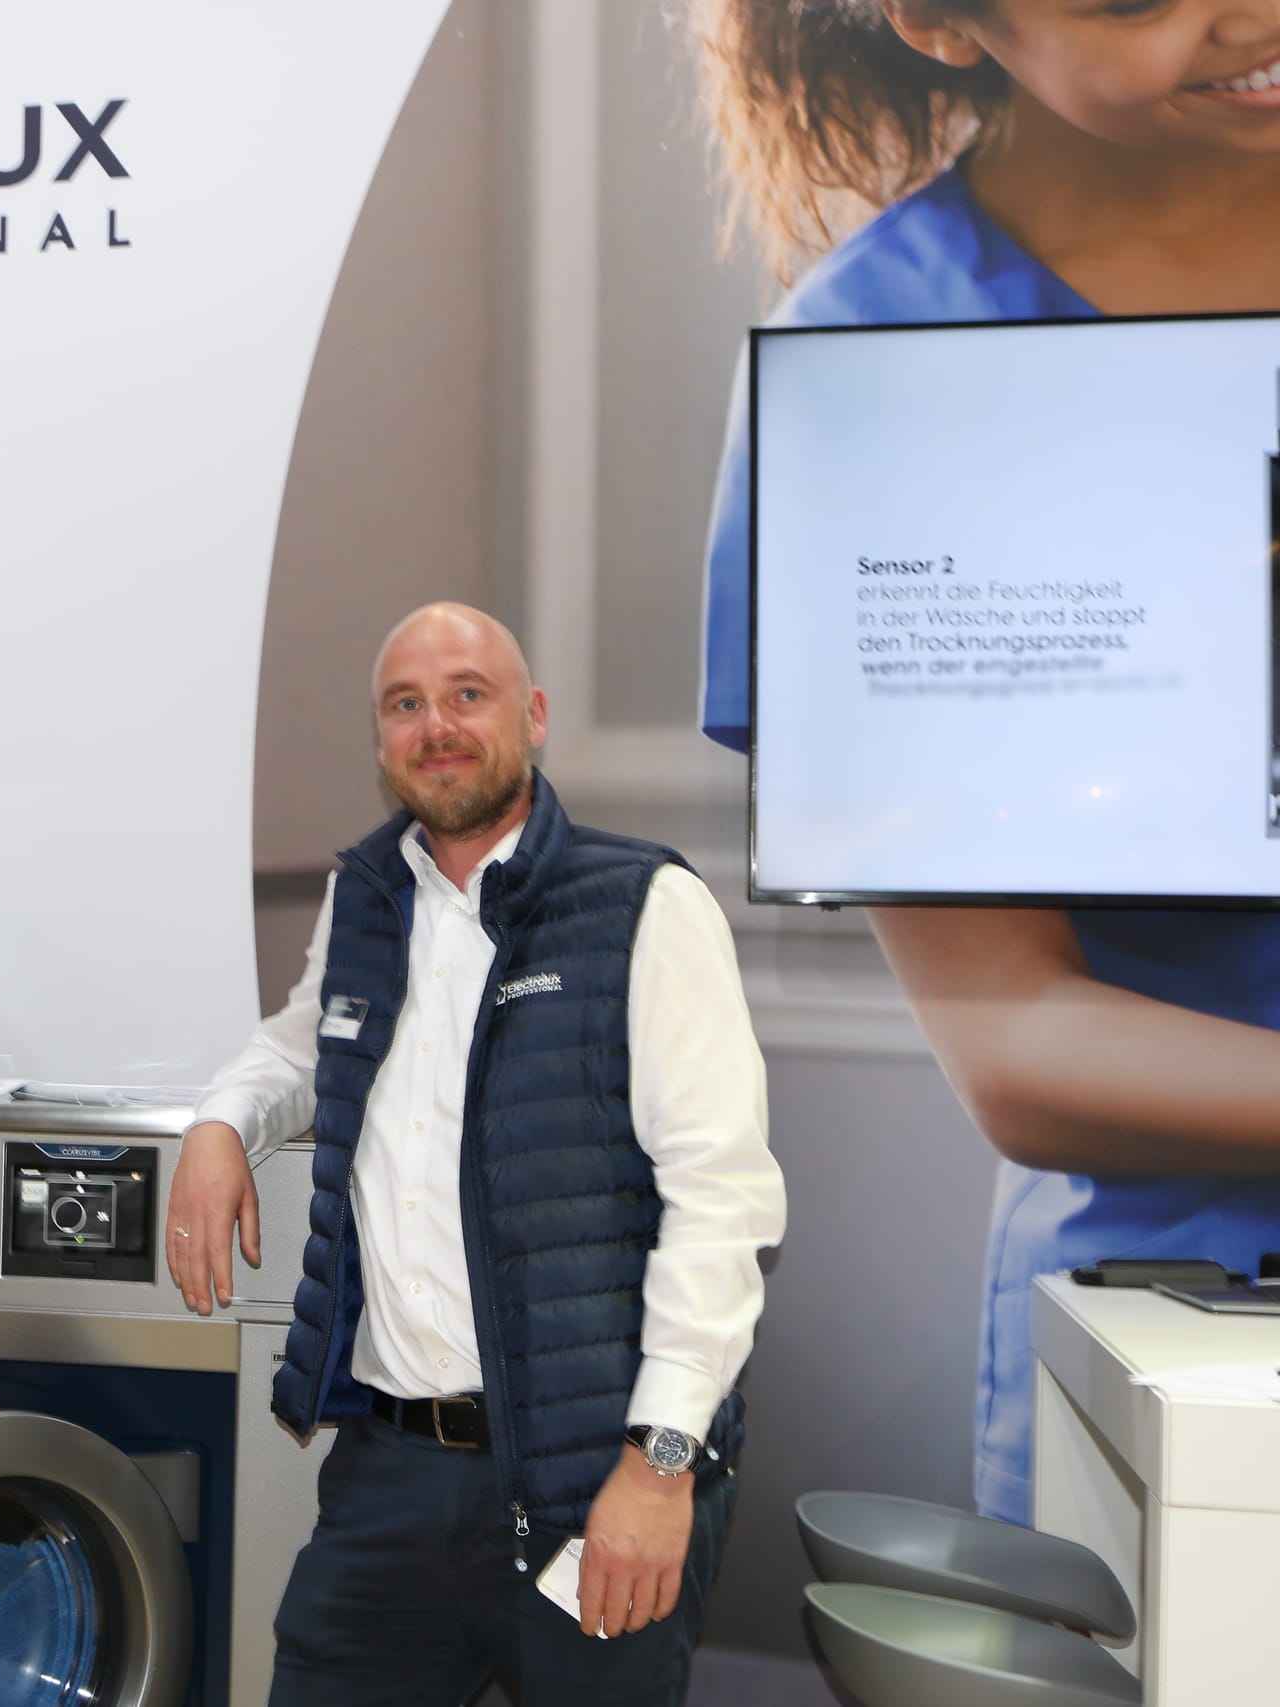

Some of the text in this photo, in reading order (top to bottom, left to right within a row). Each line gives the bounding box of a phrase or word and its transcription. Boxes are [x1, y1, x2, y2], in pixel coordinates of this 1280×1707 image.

[857, 555, 955, 576] Sensor 2
[857, 578, 1124, 604] erkennt die Feuchtigkeit
[857, 607, 876, 627] in
[882, 608, 919, 628] der
[1022, 604, 1066, 626] und
[1072, 603, 1147, 629] stoppt
[858, 633, 901, 652] den
[861, 659, 922, 677] wenn
[507, 973, 562, 994] Electrolux
[507, 985, 563, 1001] PROFESSIONAL
